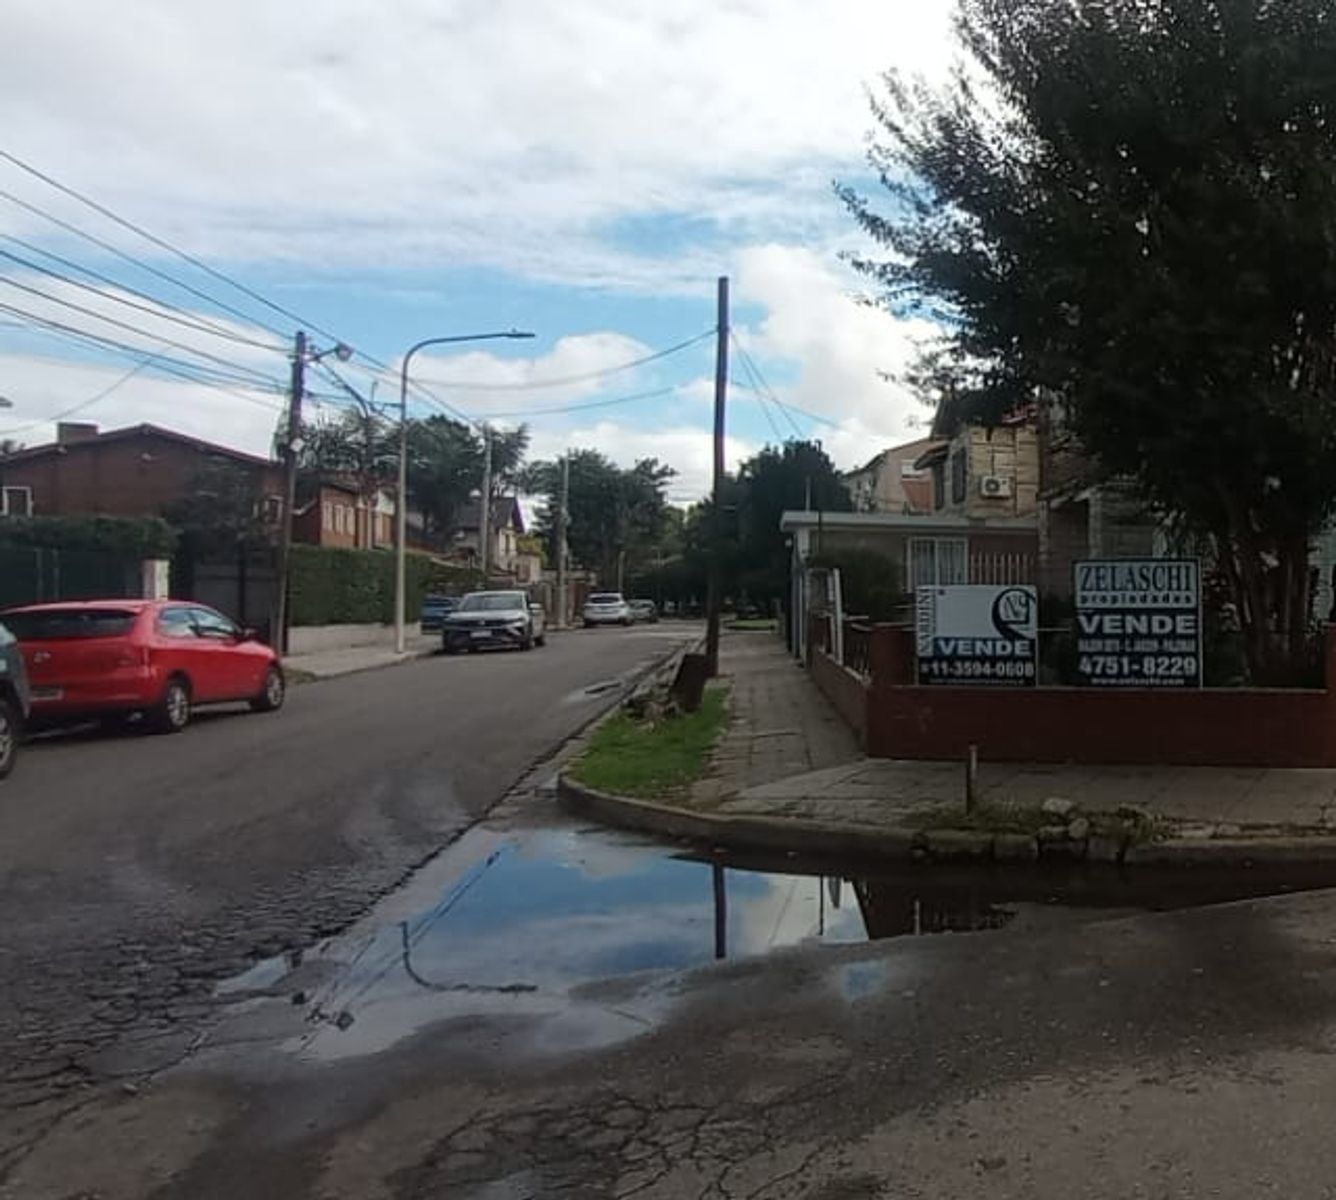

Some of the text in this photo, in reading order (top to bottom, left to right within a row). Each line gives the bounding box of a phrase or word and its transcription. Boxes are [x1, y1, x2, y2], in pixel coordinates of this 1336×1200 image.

[1080, 565, 1192, 592] ZELASCHI
[1078, 615, 1196, 634] VENDE
[937, 640, 1032, 656] VENDE
[1079, 655, 1198, 676] 4751-8229
